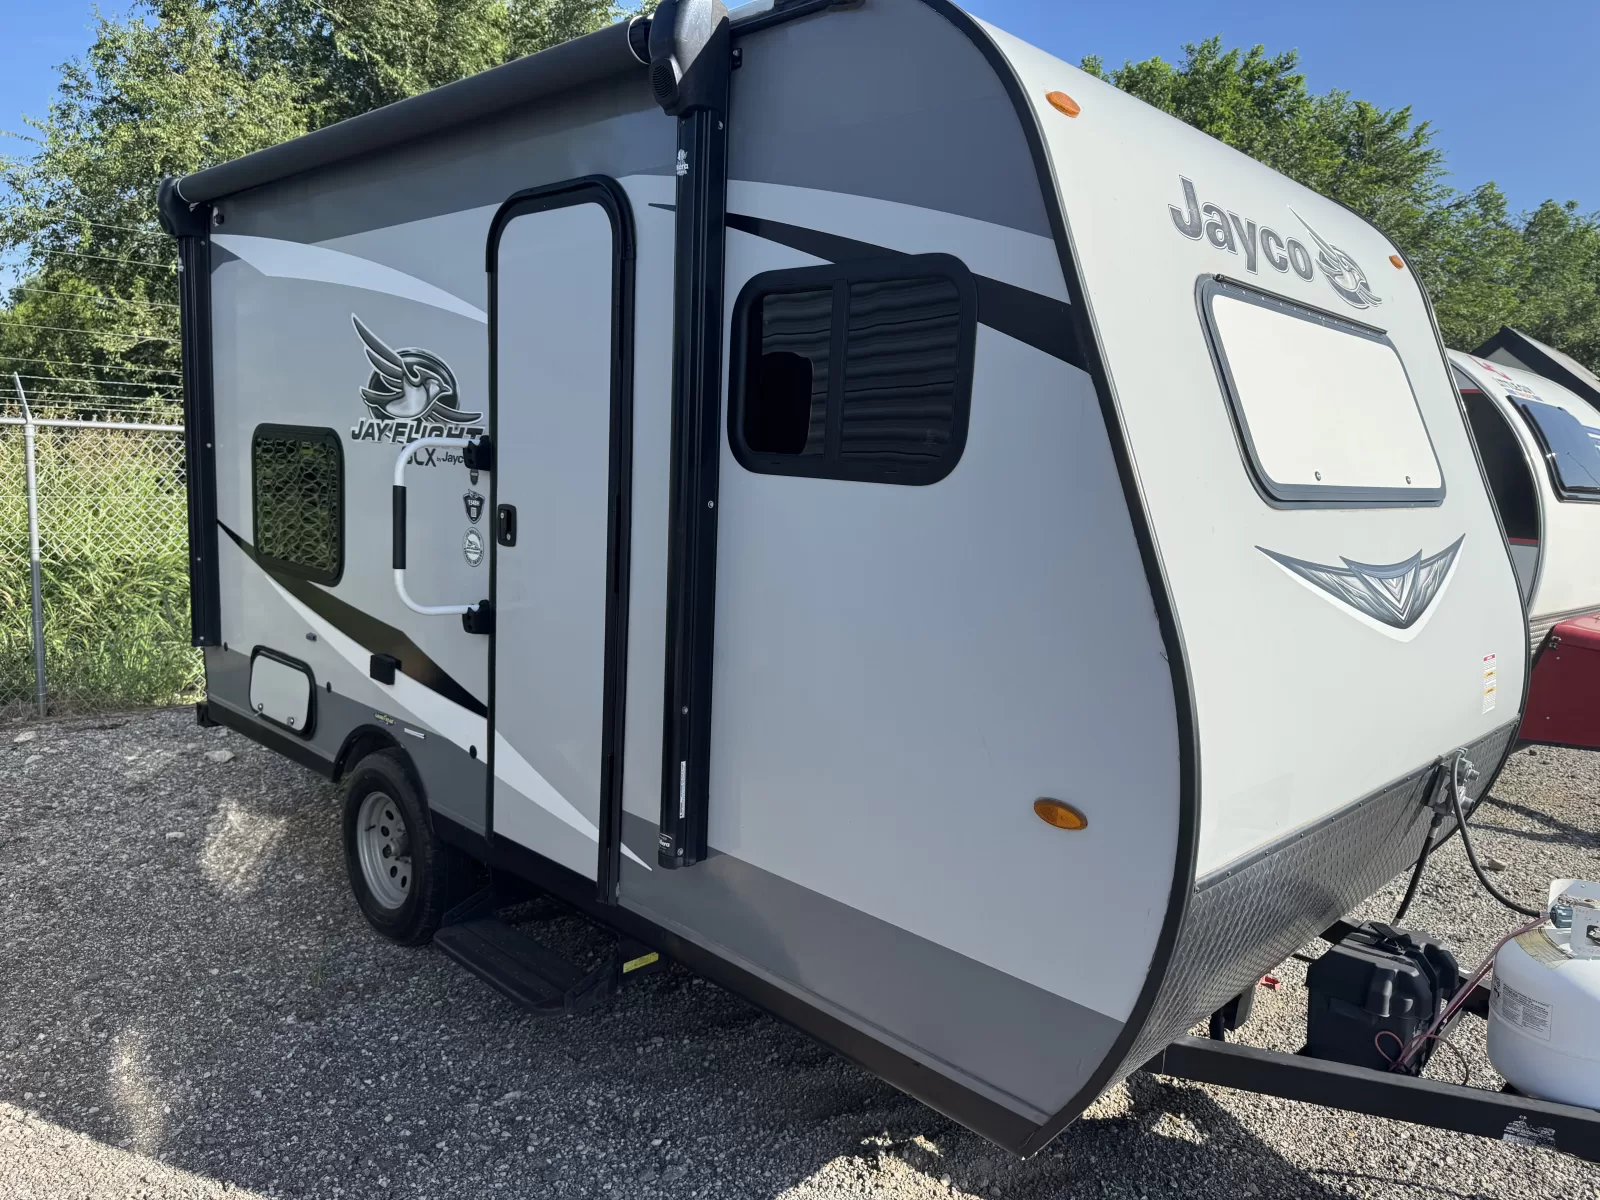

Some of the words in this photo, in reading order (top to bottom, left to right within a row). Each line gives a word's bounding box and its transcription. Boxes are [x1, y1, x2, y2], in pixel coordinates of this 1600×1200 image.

[1168, 174, 1314, 282] Jayco
[350, 418, 392, 442] JAY
[442, 451, 464, 465] Jayc
